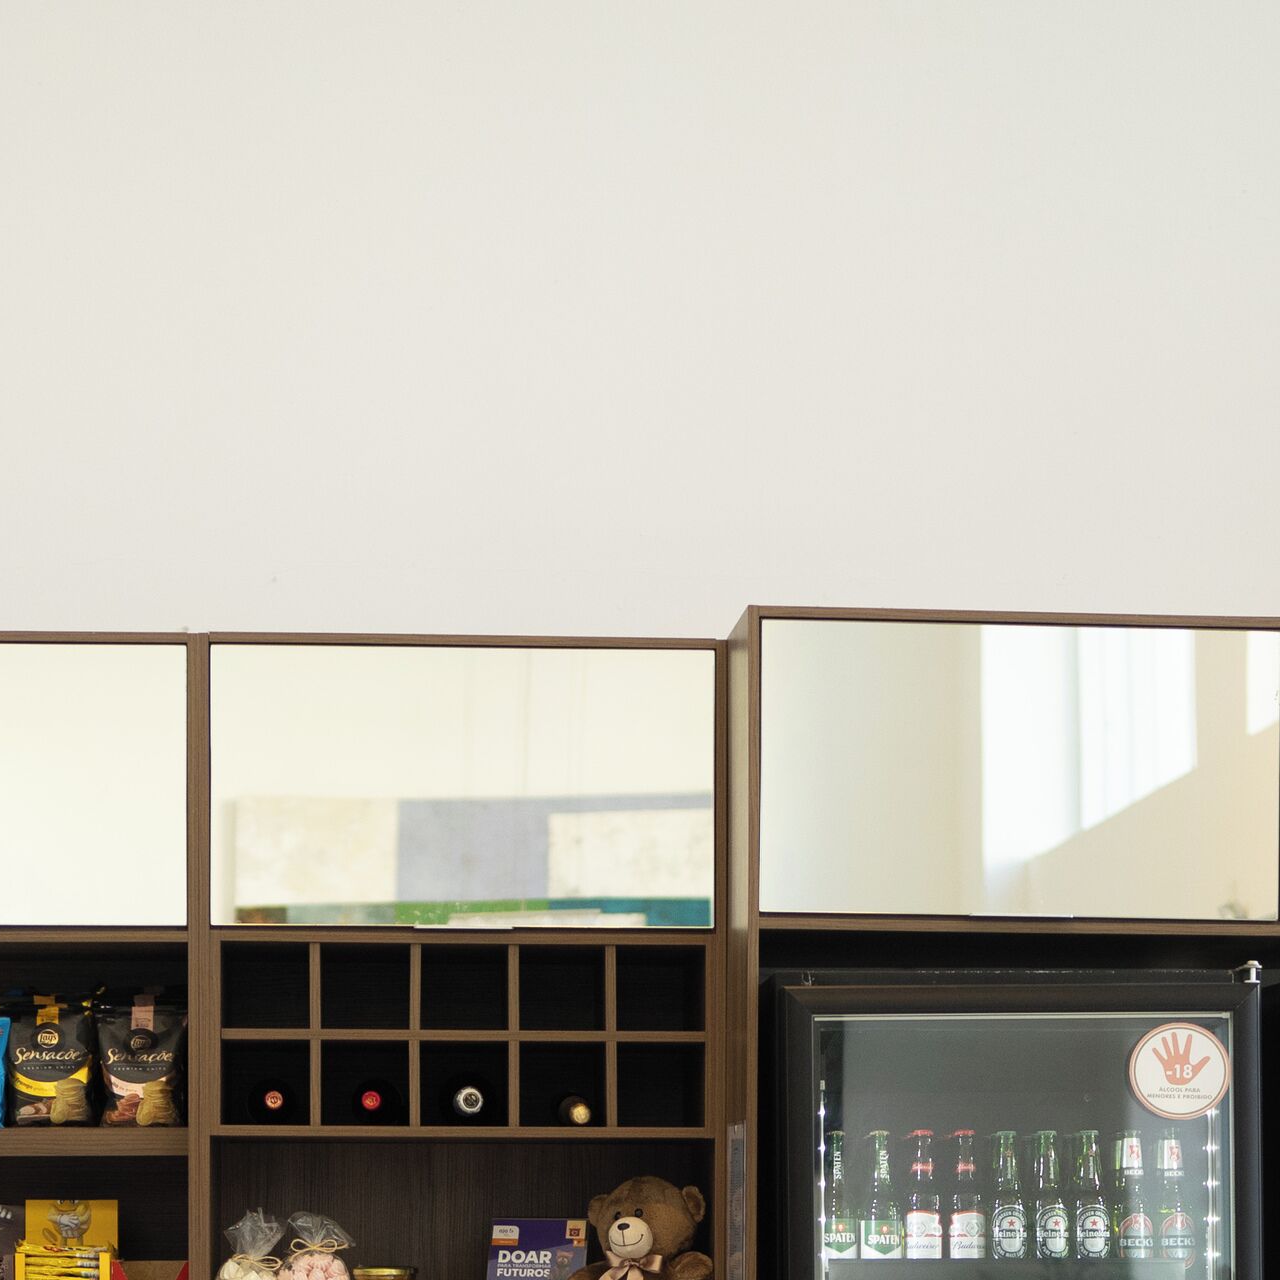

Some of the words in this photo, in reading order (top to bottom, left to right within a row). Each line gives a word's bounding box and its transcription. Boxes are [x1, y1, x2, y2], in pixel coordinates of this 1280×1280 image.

[833, 1151, 842, 1180] SPATEN
[824, 1232, 856, 1243] SPATEN
[868, 1234, 900, 1246] SPATEN
[498, 1250, 552, 1264] DOAR
[497, 1268, 550, 1277] FUTUROS
